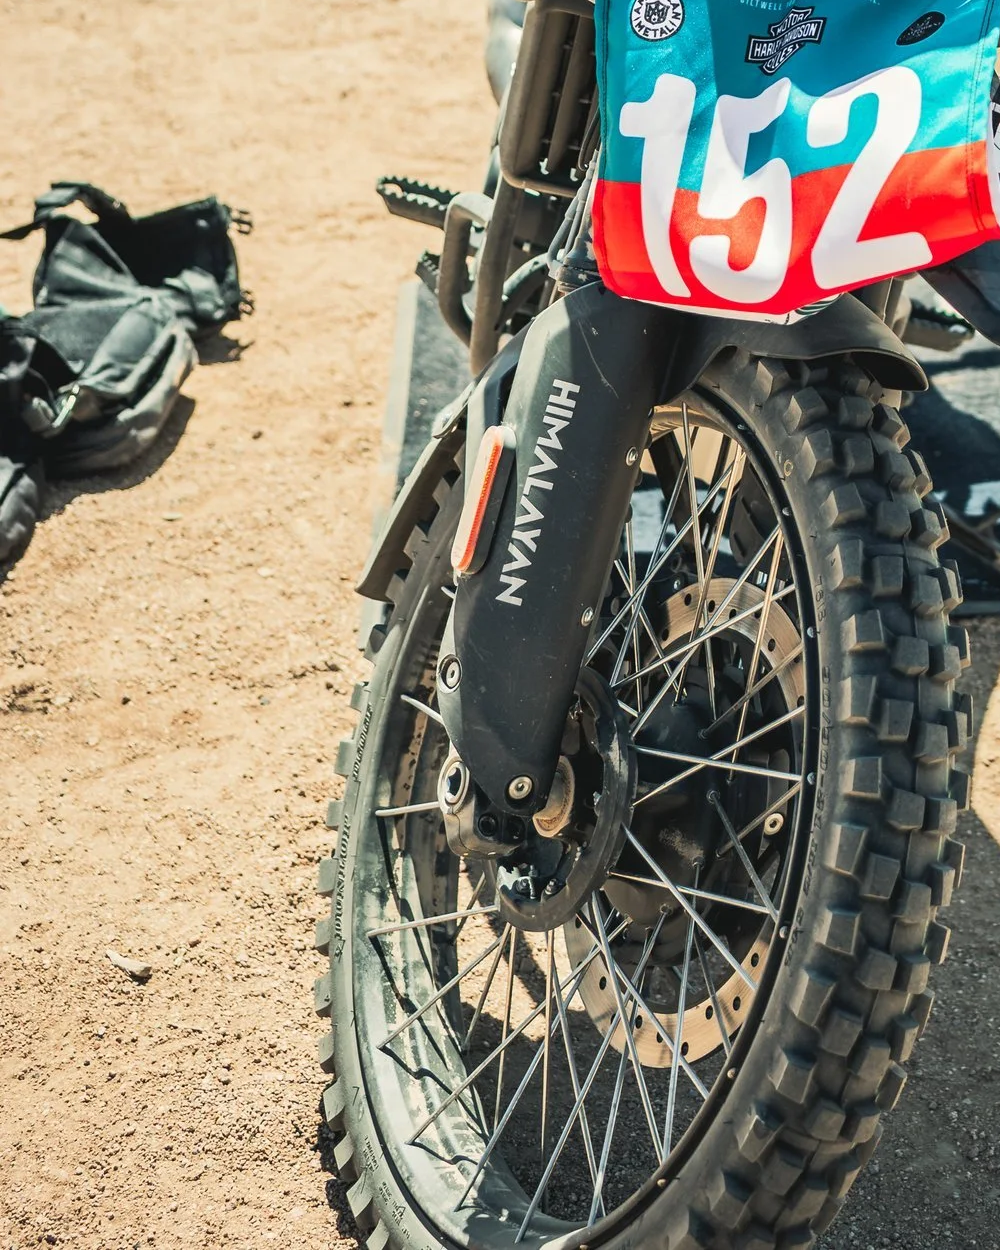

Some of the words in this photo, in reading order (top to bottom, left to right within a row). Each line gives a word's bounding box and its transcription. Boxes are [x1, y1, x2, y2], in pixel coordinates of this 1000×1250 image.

[635, 20, 675, 38] METAL
[618, 65, 934, 305] 152
[494, 378, 581, 607] HIMALAYAN
